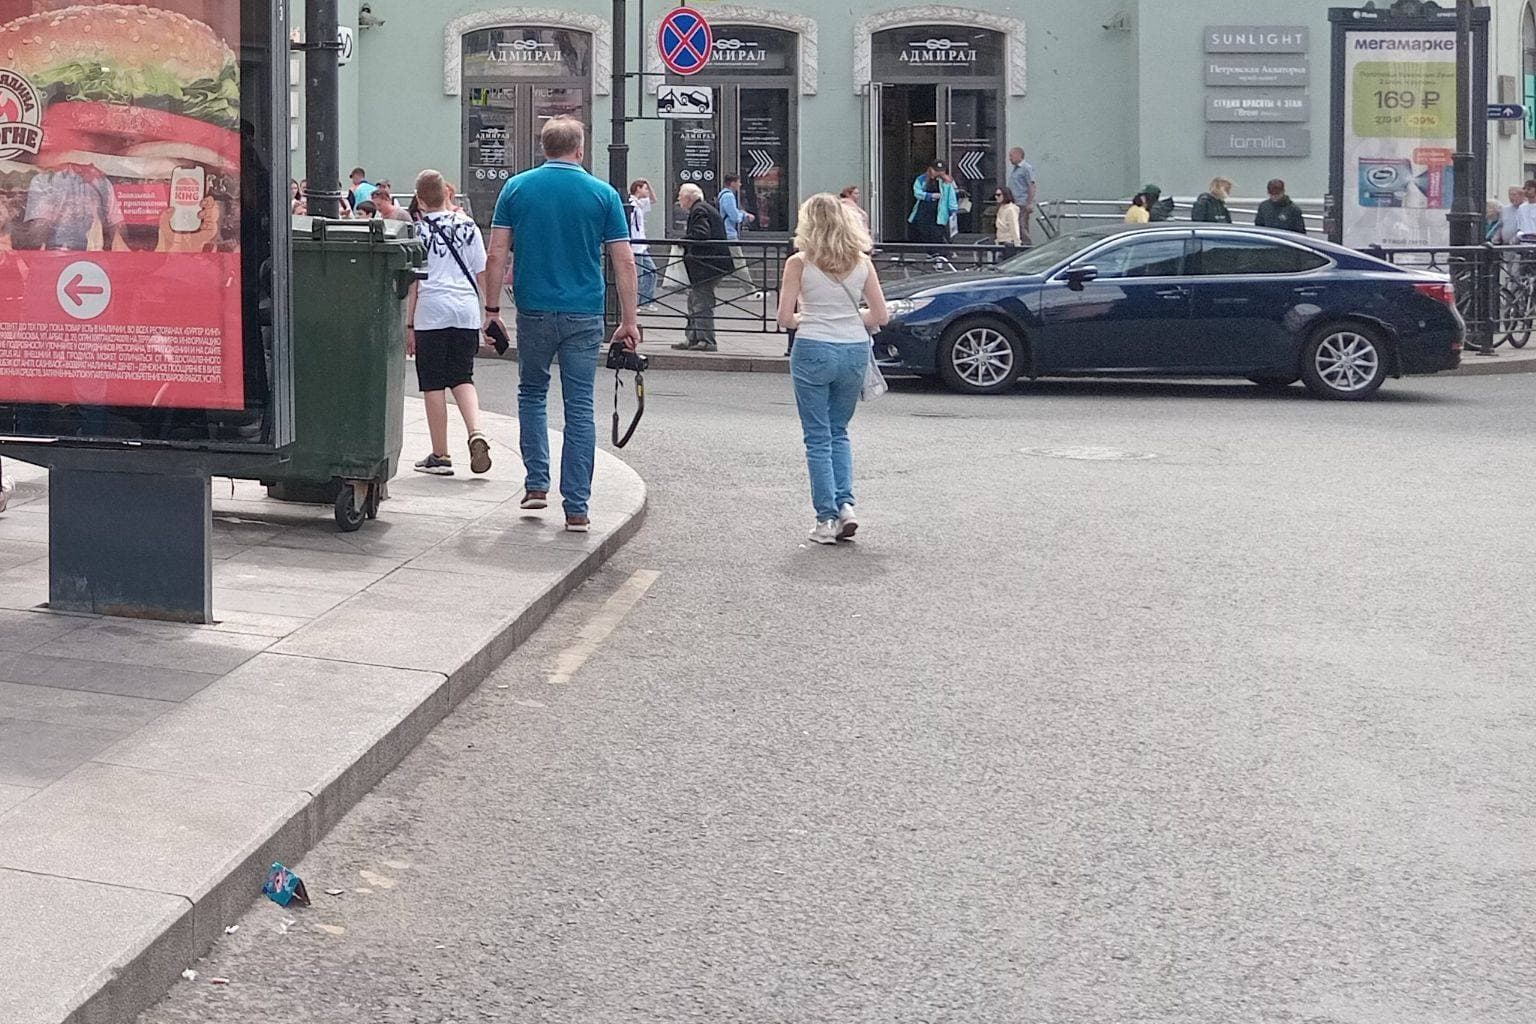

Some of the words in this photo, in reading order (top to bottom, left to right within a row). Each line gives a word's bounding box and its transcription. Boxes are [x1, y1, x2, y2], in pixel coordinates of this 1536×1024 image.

[1211, 33, 1304, 45] SUNLIGHT
[1354, 38, 1456, 53] мегамарке
[487, 50, 562, 63] АДМИРАЛ
[710, 49, 766, 62] МИРАЛ
[899, 50, 977, 63] АДМИРАЛ
[1374, 90, 1415, 109] 169
[175, 191, 199, 201] KING
